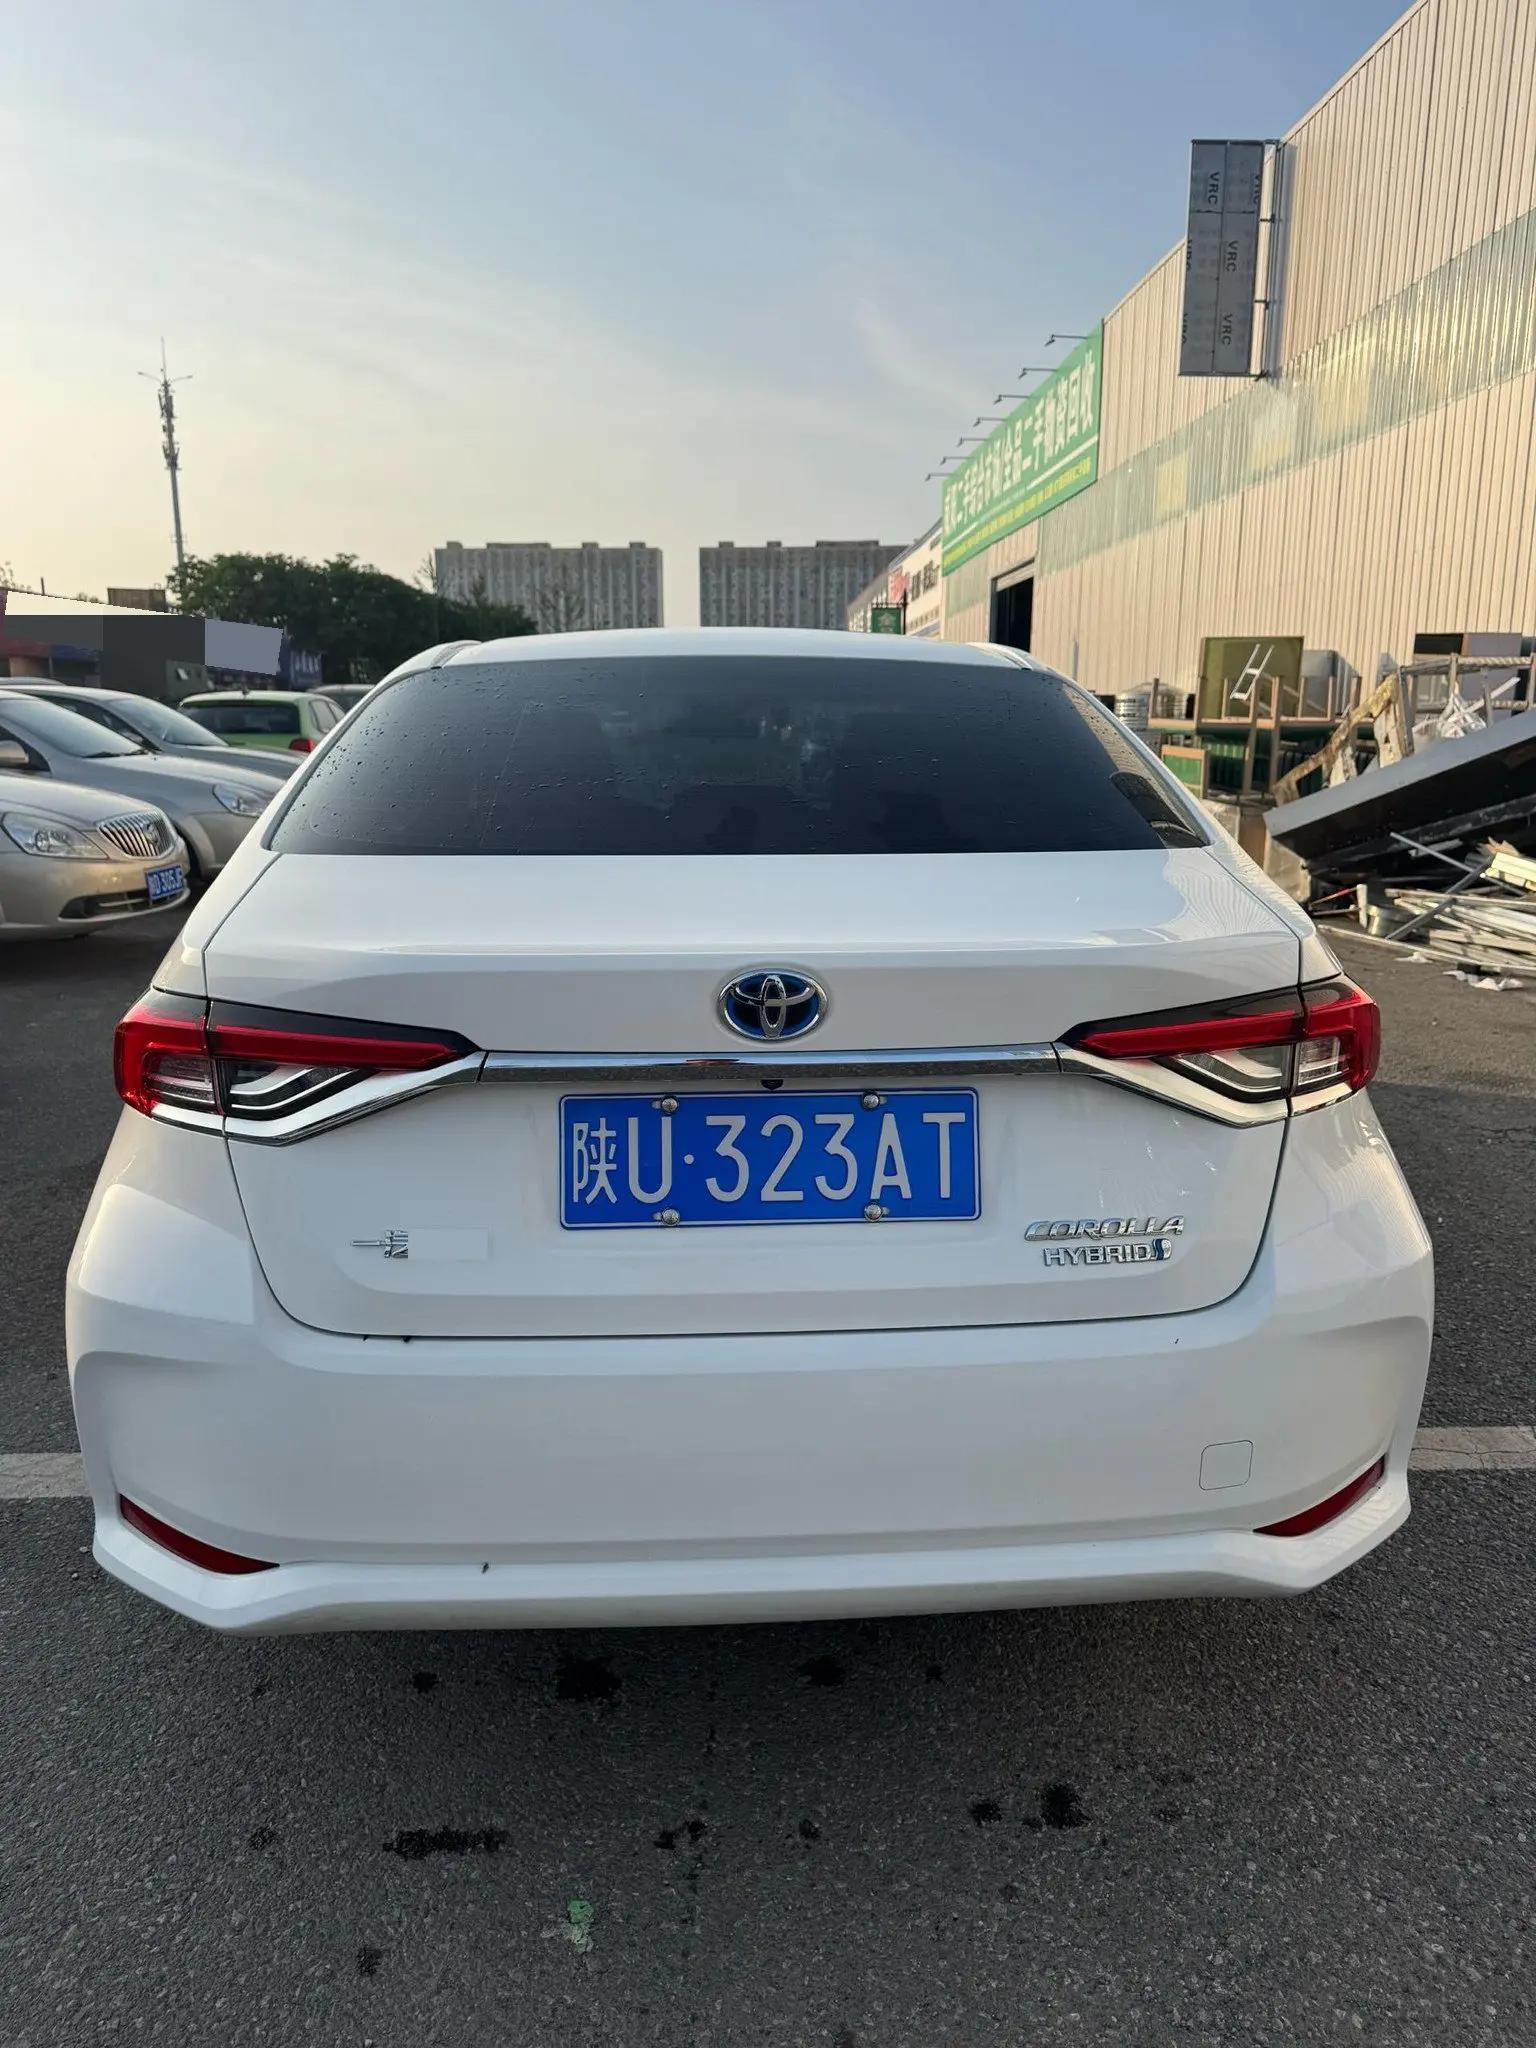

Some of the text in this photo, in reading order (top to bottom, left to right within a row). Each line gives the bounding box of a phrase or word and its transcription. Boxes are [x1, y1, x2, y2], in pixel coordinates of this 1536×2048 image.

[1208, 171, 1220, 205] VRC
[1226, 240, 1238, 272] VRC
[1222, 313, 1233, 345] VRC
[573, 1112, 967, 1205] 陕U·323AT
[1024, 1216, 1184, 1241] COROLLA
[1043, 1242, 1152, 1266] HYBRID
